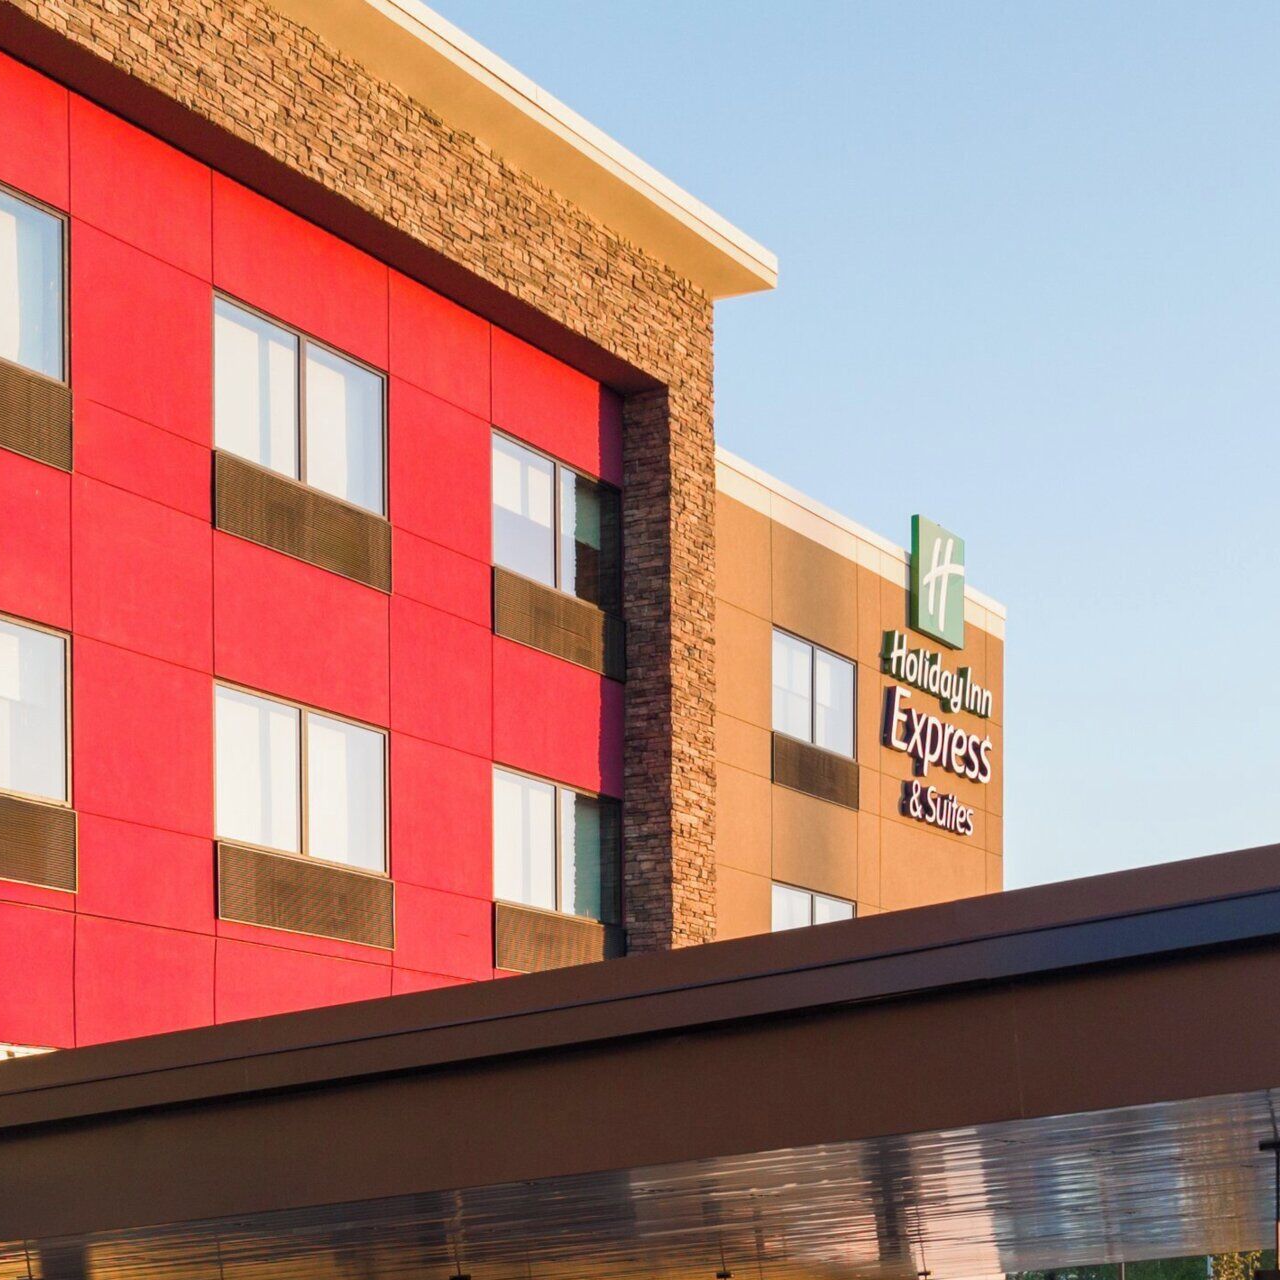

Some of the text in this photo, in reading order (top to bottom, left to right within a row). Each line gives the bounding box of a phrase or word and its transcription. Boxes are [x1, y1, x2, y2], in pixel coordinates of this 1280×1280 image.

[888, 630, 993, 718] Holiday Inn
[889, 685, 993, 784] Express
[908, 779, 974, 836] & Suites
